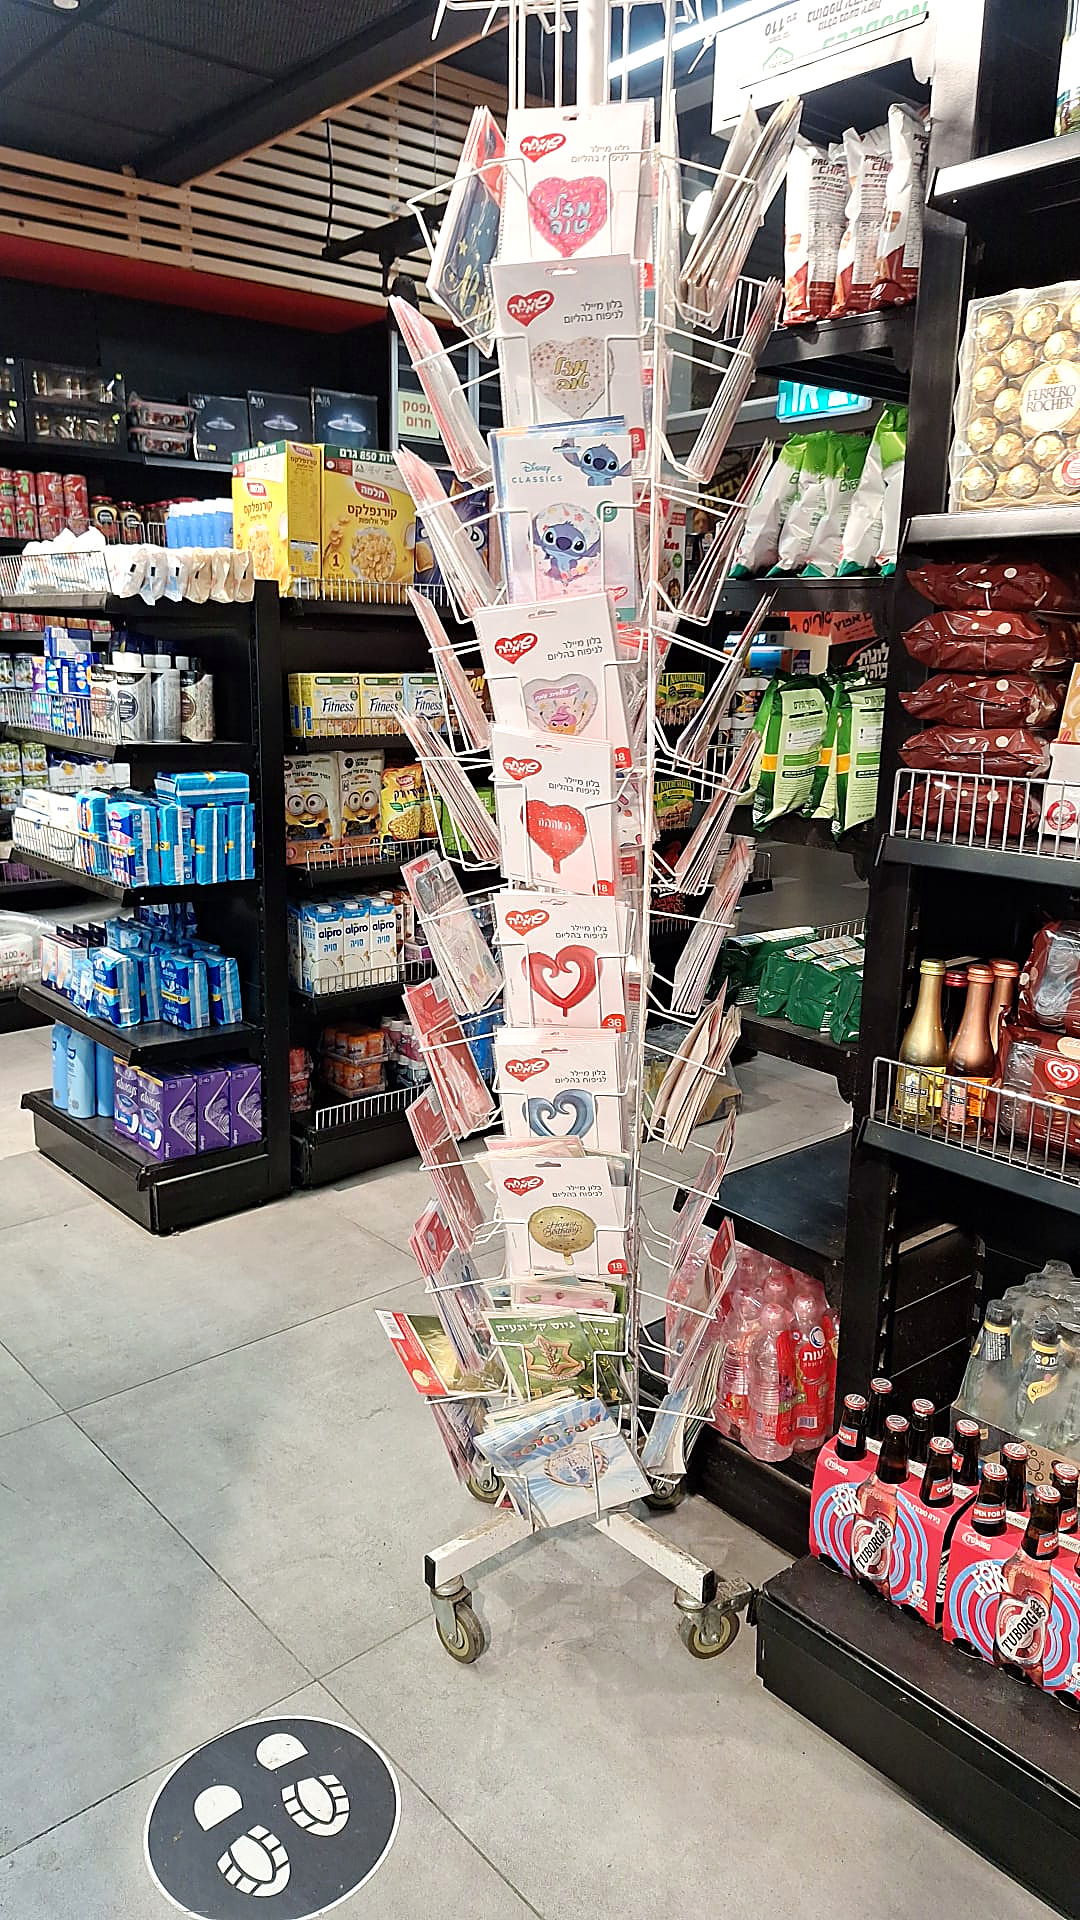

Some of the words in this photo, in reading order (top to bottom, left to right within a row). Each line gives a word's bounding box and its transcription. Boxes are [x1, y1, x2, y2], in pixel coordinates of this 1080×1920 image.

[765, 18, 785, 36] 110
[603, 153, 630, 163] לניפח
[549, 193, 591, 218] מזל
[550, 219, 589, 235] טוב
[579, 301, 604, 310] מיילר
[606, 299, 623, 310] בלון
[563, 311, 594, 324] בהליום
[595, 309, 624, 320] לניפוח
[553, 356, 588, 375] מזל
[1027, 385, 1076, 401] FERRERO
[1026, 397, 1074, 413] ROCHER
[406, 416, 431, 429] חרום
[340, 448, 357, 459] גרם
[360, 451, 377, 461] 850
[520, 462, 551, 473] Disney
[511, 475, 563, 484] CLASSICS
[360, 486, 385, 499] תלמה
[244, 501, 273, 516] קורנפלקס
[347, 504, 398, 520] קורנפלקס
[381, 518, 390, 526] של
[333, 554, 340, 567] 1
[562, 639, 585, 648] מיילר
[586, 637, 602, 647] בלון
[547, 650, 576, 661] בהליום
[577, 645, 603, 657] לניפוח
[470, 677, 485, 692] ON
[322, 697, 355, 713] Fitness
[370, 697, 399, 712] Fitness
[414, 696, 443, 712] Fitness
[564, 776, 584, 786] מיילר
[586, 778, 600, 787] בלון
[548, 782, 574, 792] בהליום
[576, 784, 600, 796] לניפוח
[345, 924, 368, 936] alpro
[372, 920, 395, 932] alpro
[570, 924, 592, 932] מיילר
[592, 925, 608, 934] בלון
[318, 928, 342, 940] alpro
[377, 935, 391, 944] סויה
[583, 931, 608, 940] לניפוח
[323, 944, 337, 953] סויה
[350, 939, 364, 948] סויה
[607, 1018, 622, 1027] 36
[592, 1069, 606, 1078] בלון
[555, 1076, 581, 1084] בהליום
[583, 1076, 607, 1085] לניפוח
[117, 1079, 138, 1098] always
[588, 1184, 602, 1192] בלון
[610, 1262, 623, 1271] 18
[496, 1323, 528, 1333] ונעים
[529, 1322, 547, 1332] קל
[551, 1321, 576, 1330] גיוס
[594, 1328, 610, 1336] גיו
[803, 1349, 826, 1361] עות
[1035, 1354, 1057, 1366] SOD
[831, 1487, 858, 1504] FOR
[834, 1499, 862, 1520] FUN
[856, 1530, 885, 1568] TUBORG
[971, 1564, 1003, 1582] FOR
[912, 1581, 924, 1598] 6
[974, 1577, 1011, 1600] FUN
[1001, 1611, 1039, 1652] TUBORG
